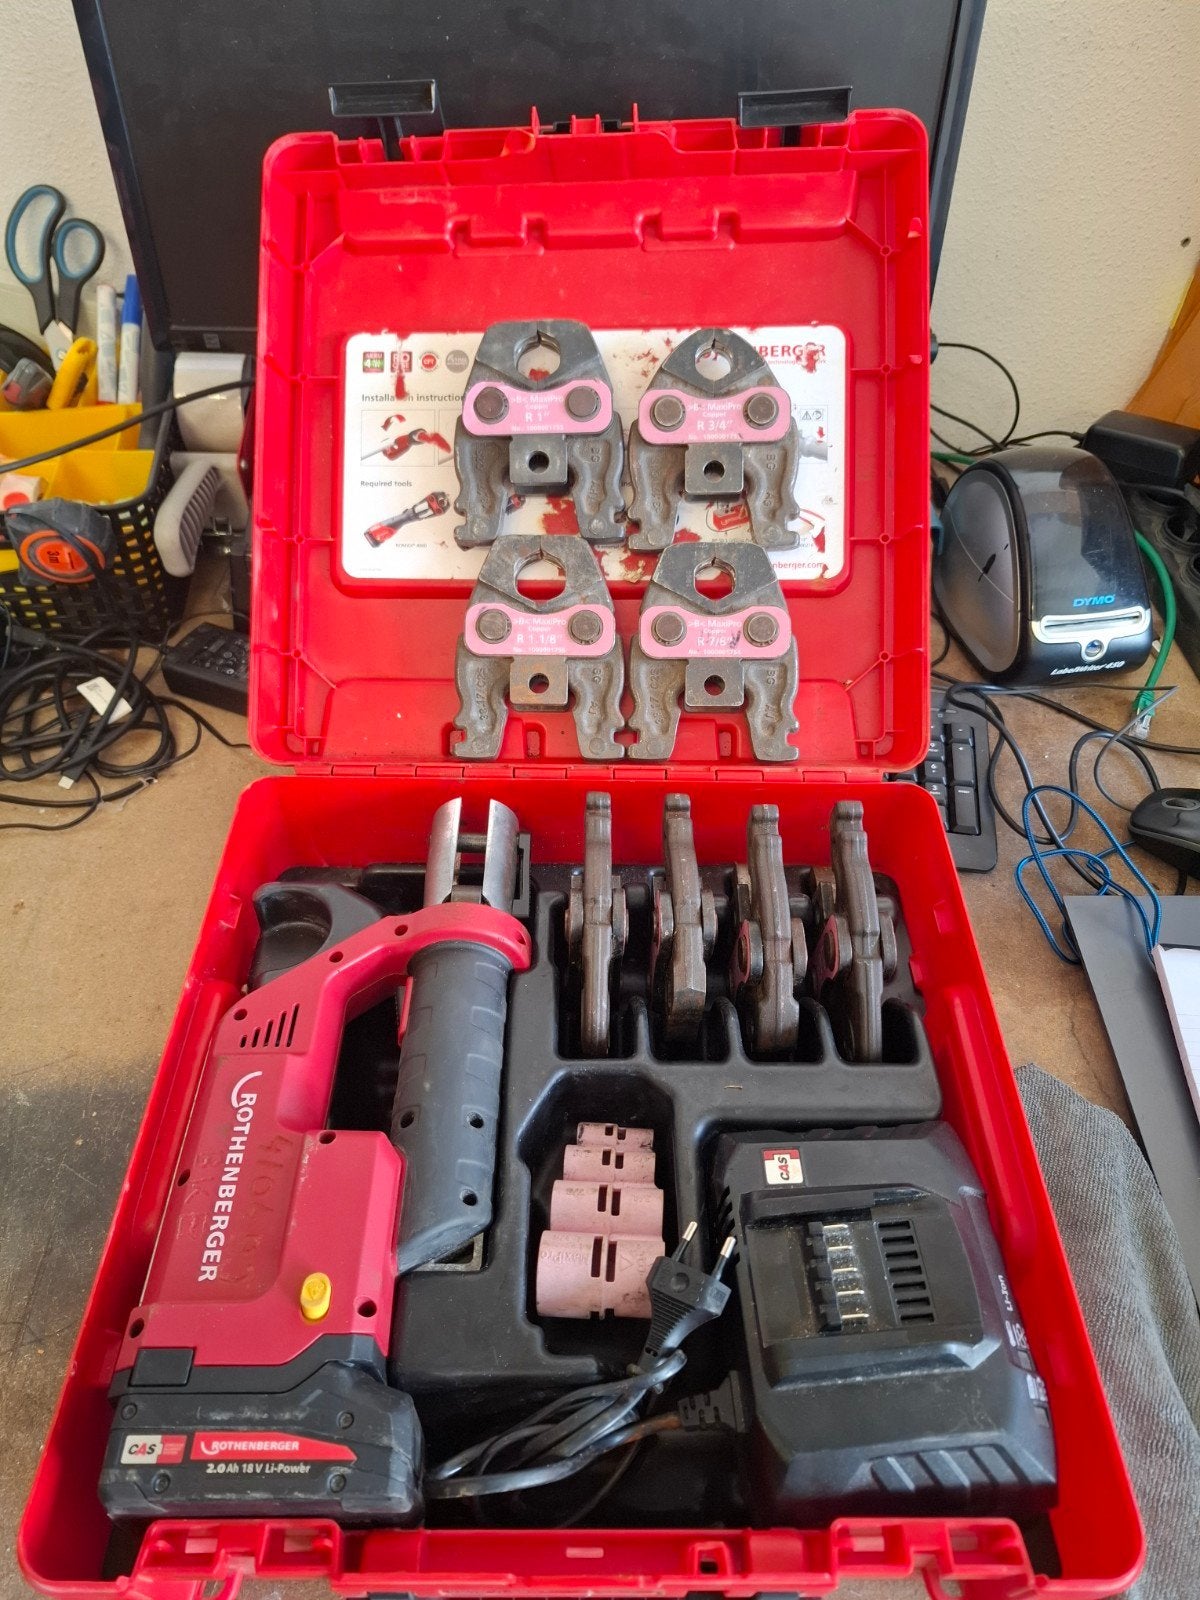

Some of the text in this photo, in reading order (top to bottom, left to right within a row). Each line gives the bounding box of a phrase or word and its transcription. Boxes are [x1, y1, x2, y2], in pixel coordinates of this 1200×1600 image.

[525, 412, 532, 422] R
[697, 421, 704, 430] R
[360, 480, 392, 488] Required
[1072, 594, 1115, 608] DYMO
[532, 618, 567, 626] MaxiPro
[708, 620, 742, 628] MaxiPro
[517, 634, 524, 643] R
[697, 637, 704, 646] R
[1050, 664, 1106, 676] LabelWriter
[777, 1156, 790, 1180] CAS
[197, 1070, 263, 1284] ROTHENBERGER
[128, 1444, 157, 1456] CAS
[201, 1440, 300, 1456] ROTHENBERGER
[266, 1463, 312, 1474] Li-Power
